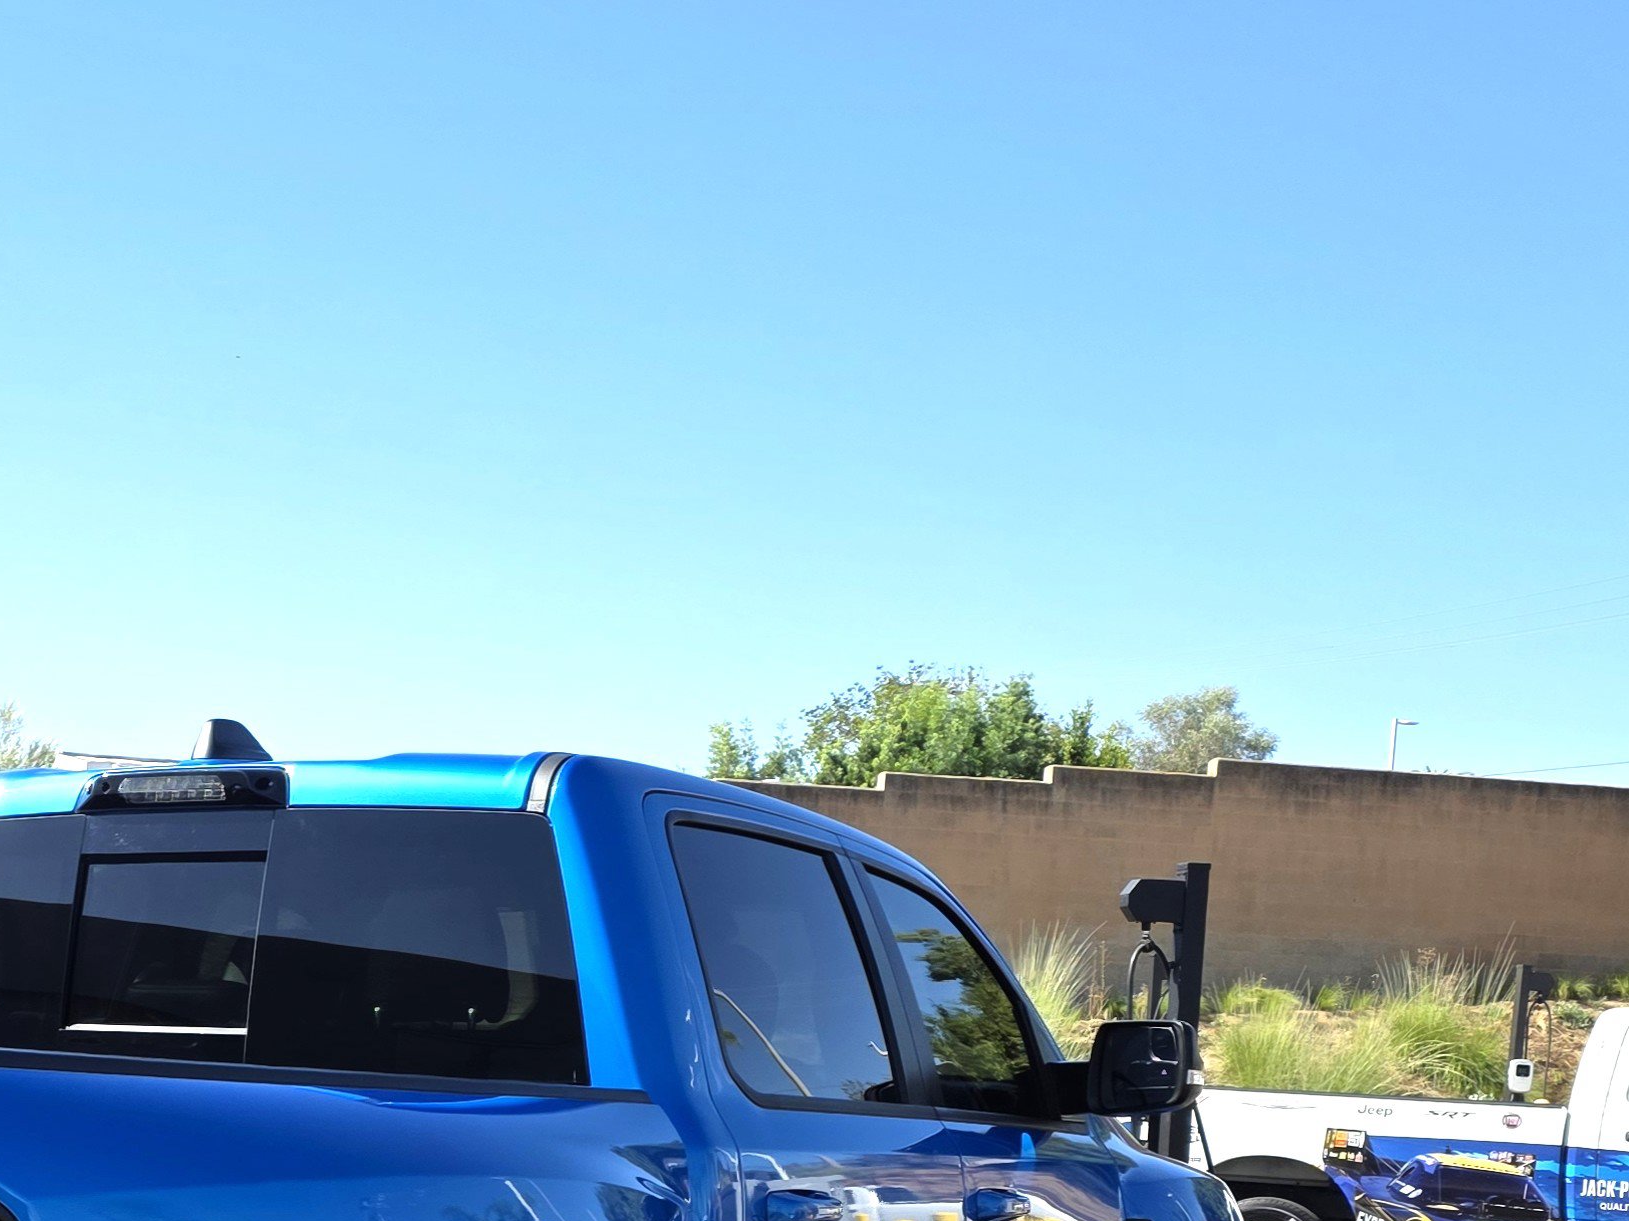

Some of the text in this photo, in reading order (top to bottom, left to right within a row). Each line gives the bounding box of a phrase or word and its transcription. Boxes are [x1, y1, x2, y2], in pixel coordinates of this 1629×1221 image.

[1357, 1104, 1393, 1117] Jeep
[1425, 1109, 1476, 1119] SRT
[1580, 1178, 1629, 1199] JACK P
